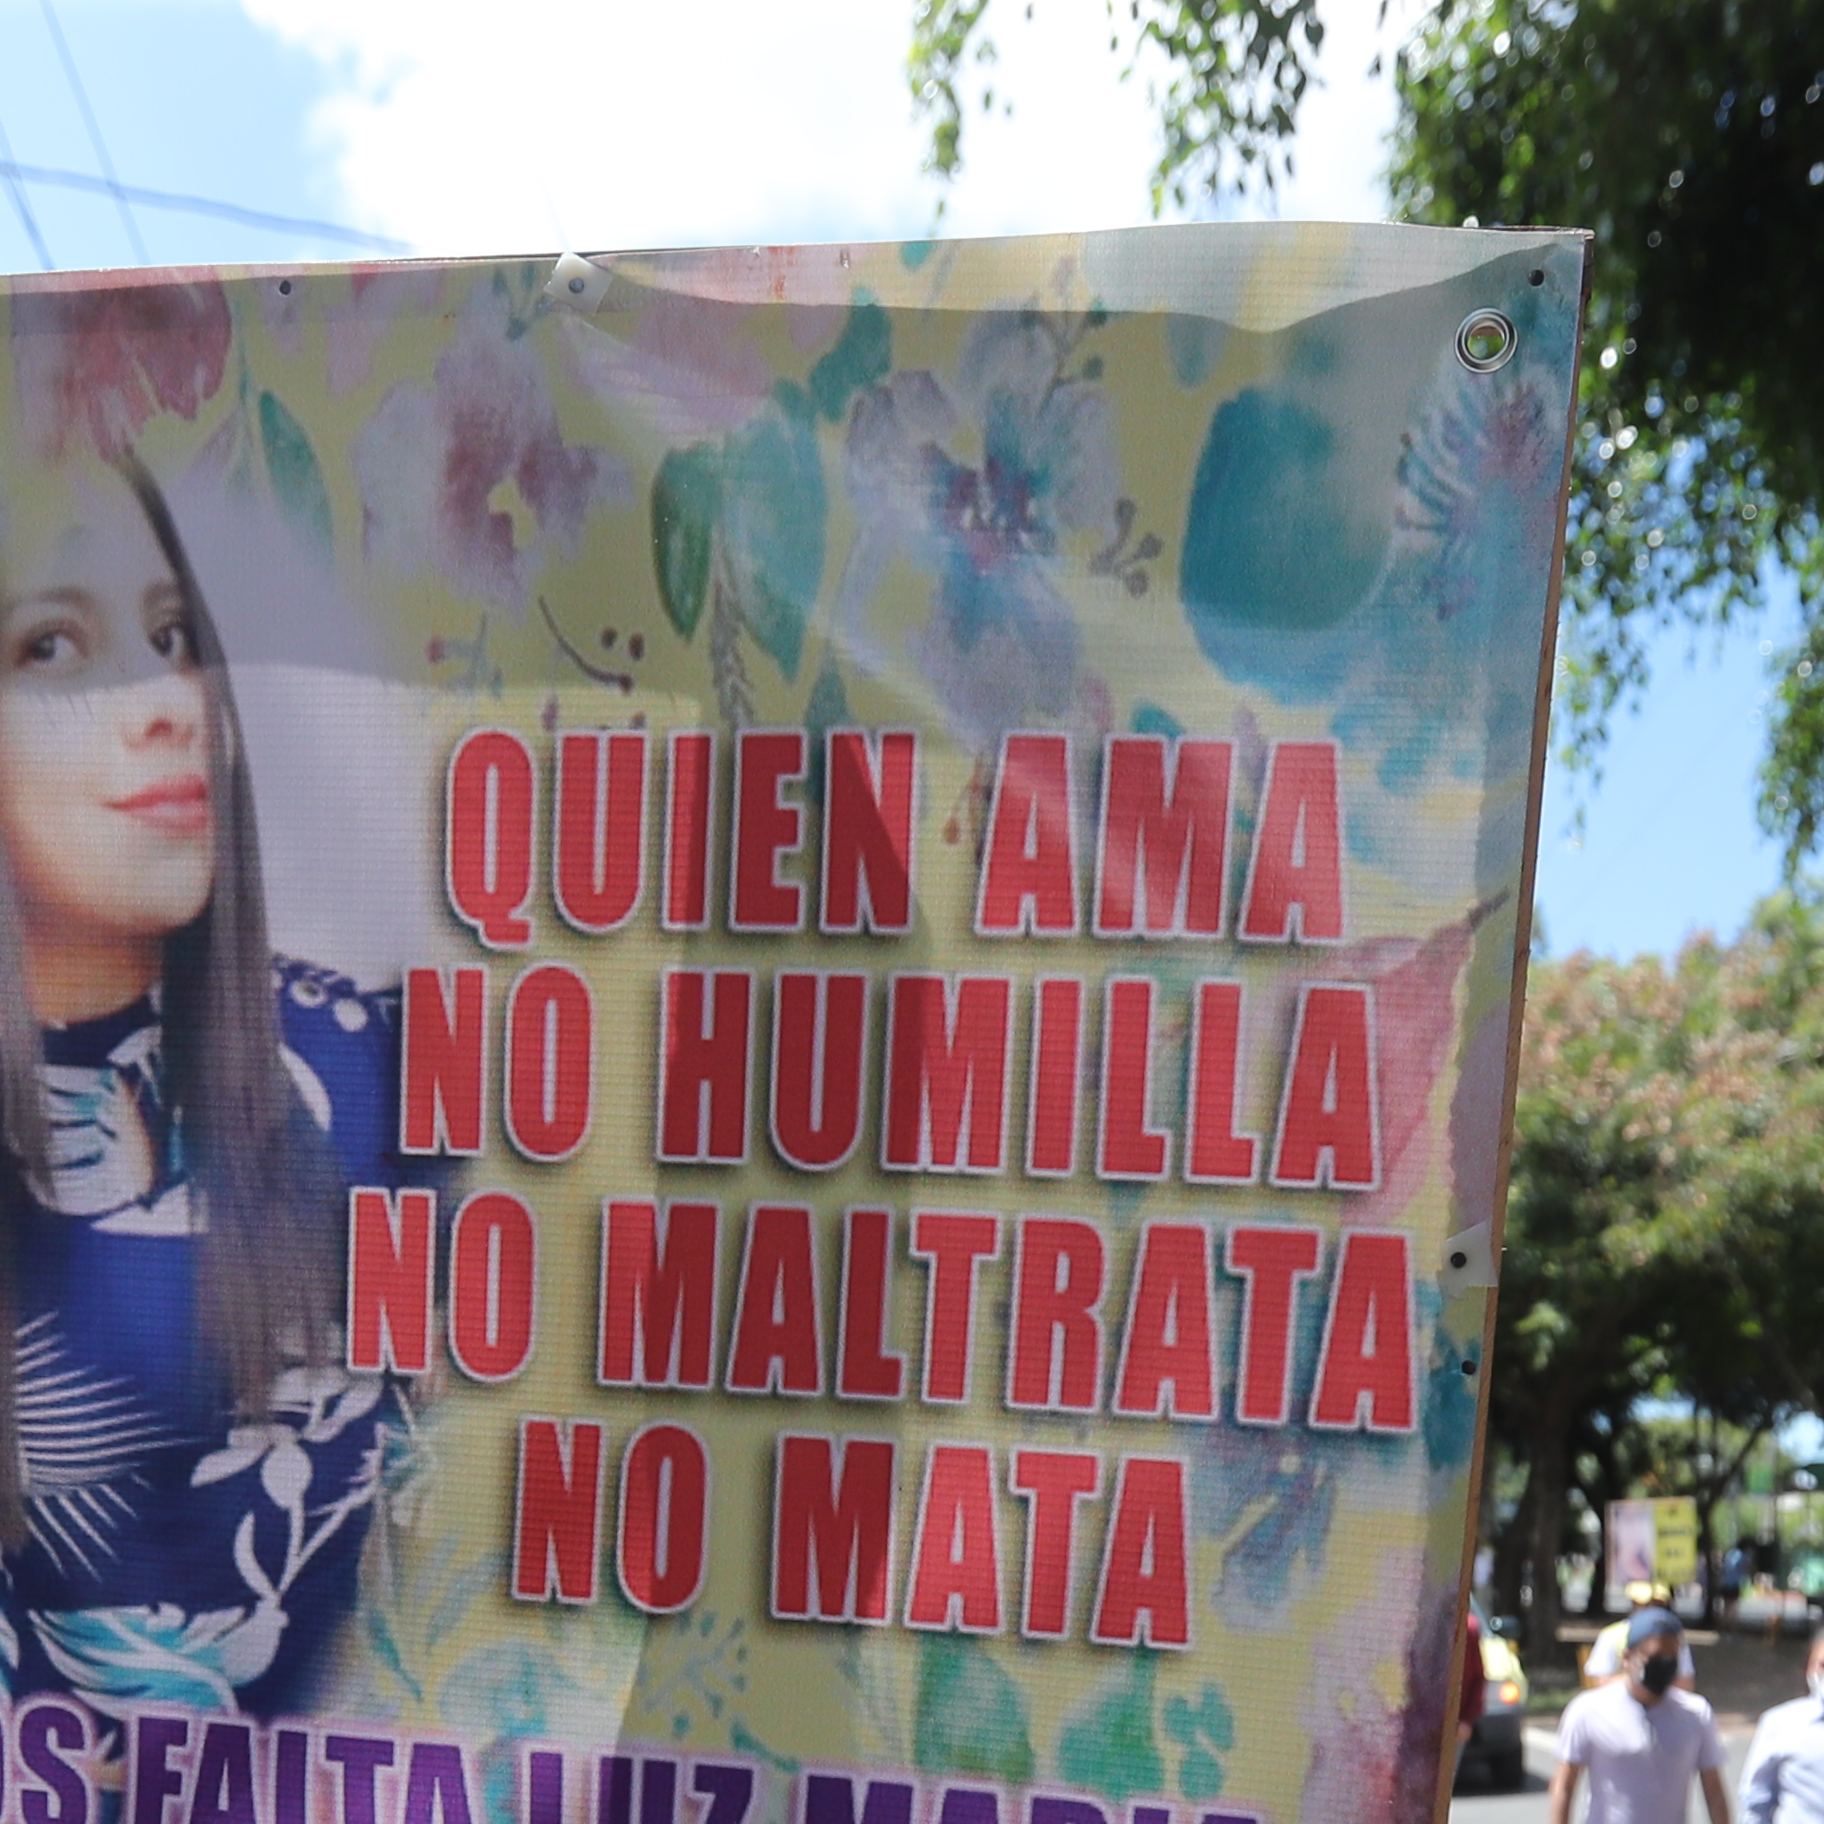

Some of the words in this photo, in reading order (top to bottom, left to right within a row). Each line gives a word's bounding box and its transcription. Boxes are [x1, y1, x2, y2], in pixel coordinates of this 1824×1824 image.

[447, 728, 918, 948] QUIEN
[978, 734, 1344, 942] AMA
[402, 963, 596, 1159] NO
[658, 968, 1378, 1187] HUMILLA
[349, 1188, 538, 1381] NO
[598, 1197, 1416, 1432] MALTRATA
[513, 1417, 711, 1612] NO
[772, 1433, 1193, 1649] MATA
